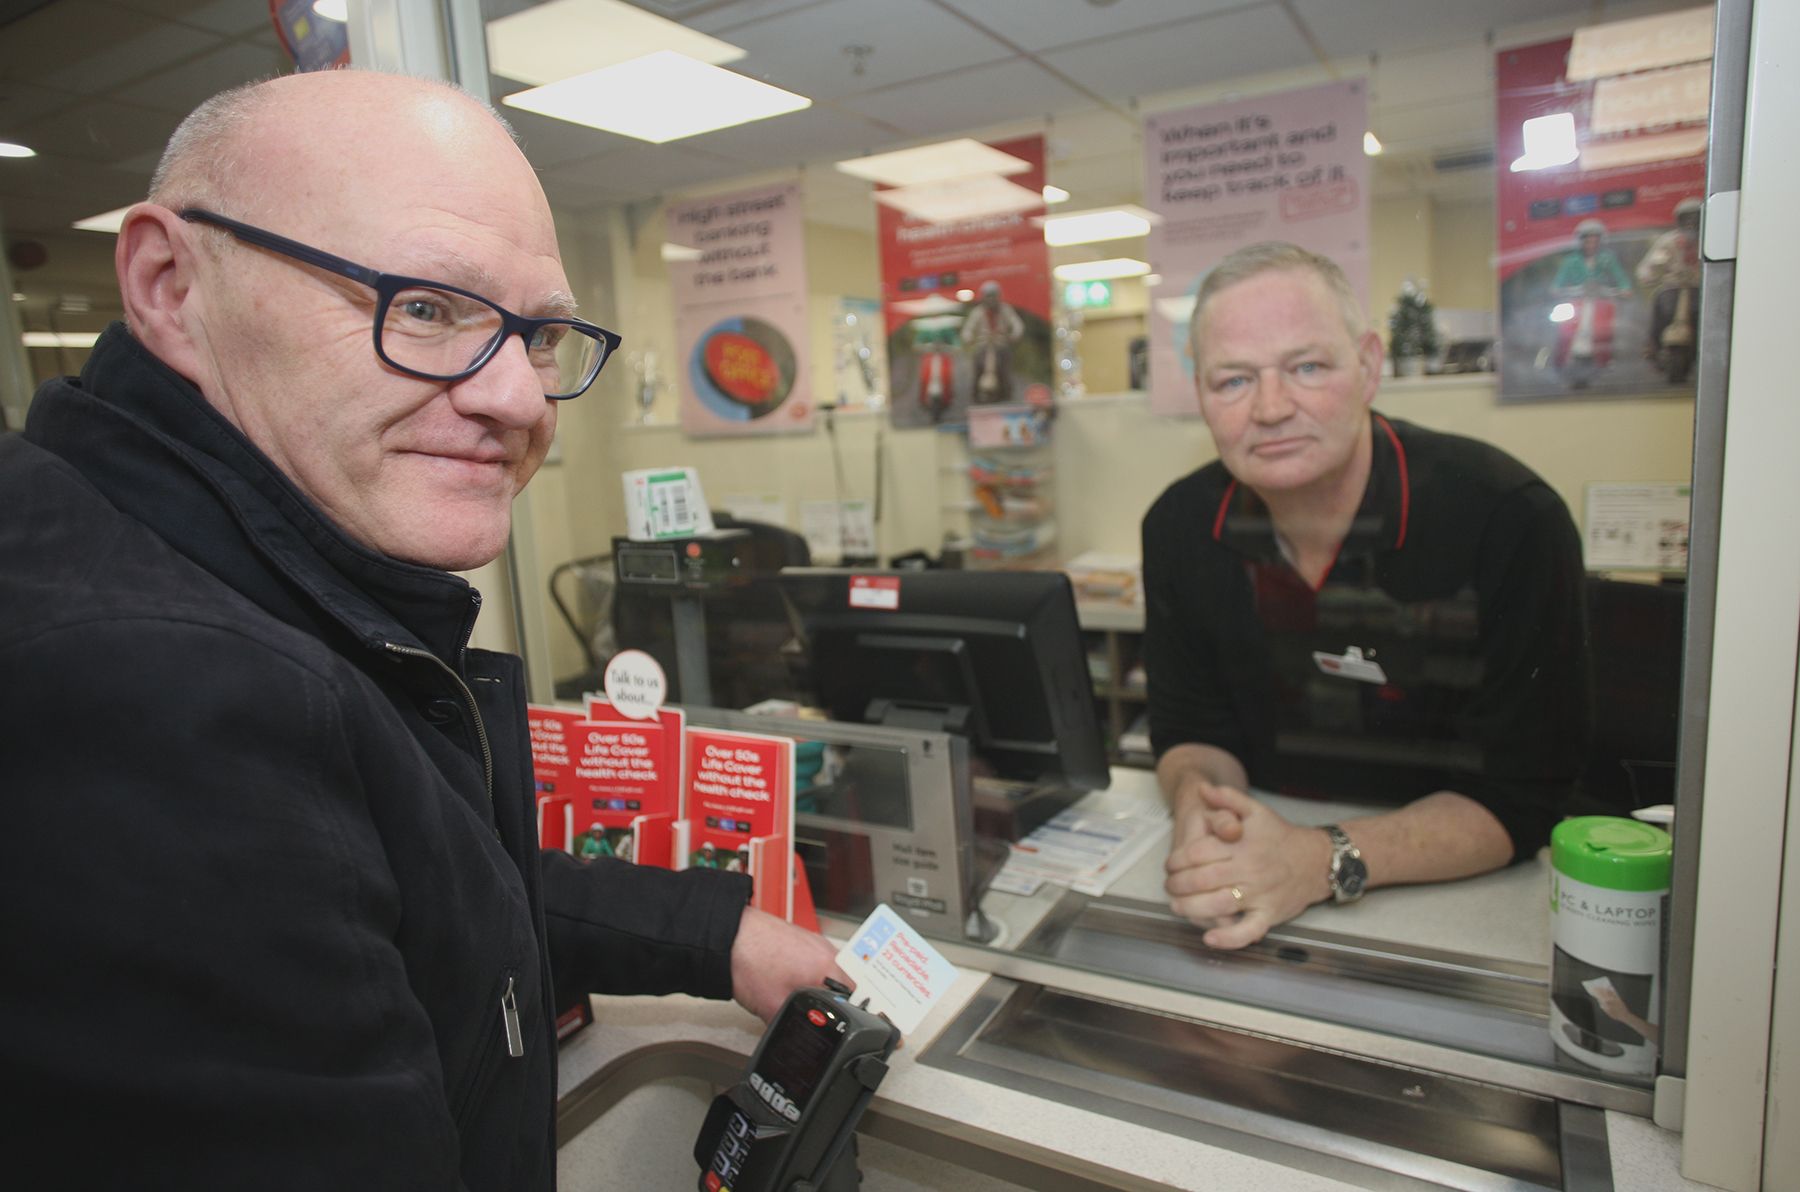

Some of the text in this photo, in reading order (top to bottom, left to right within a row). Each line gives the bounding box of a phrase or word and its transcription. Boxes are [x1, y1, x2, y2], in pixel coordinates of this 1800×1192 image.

[1160, 121, 1232, 144] When
[1161, 120, 1337, 164] important and
[1162, 150, 1306, 185] you need to
[1162, 183, 1222, 204] keep
[1226, 172, 1290, 195] track
[1295, 164, 1323, 186] of
[726, 194, 785, 217] street
[693, 219, 769, 245] banking
[700, 243, 769, 264] without
[694, 270, 724, 288] the
[611, 668, 658, 687] Talk to us
[588, 731, 646, 745] Over 50s
[584, 744, 648, 757] Life Cover
[705, 744, 760, 763] Over 50s
[580, 756, 654, 770] without the
[701, 757, 763, 775] Life Cover
[576, 767, 657, 781] health check
[697, 770, 767, 789] without the
[693, 780, 770, 802] health check
[1581, 900, 1588, 910] &
[1595, 905, 1656, 919] LAPTOP
